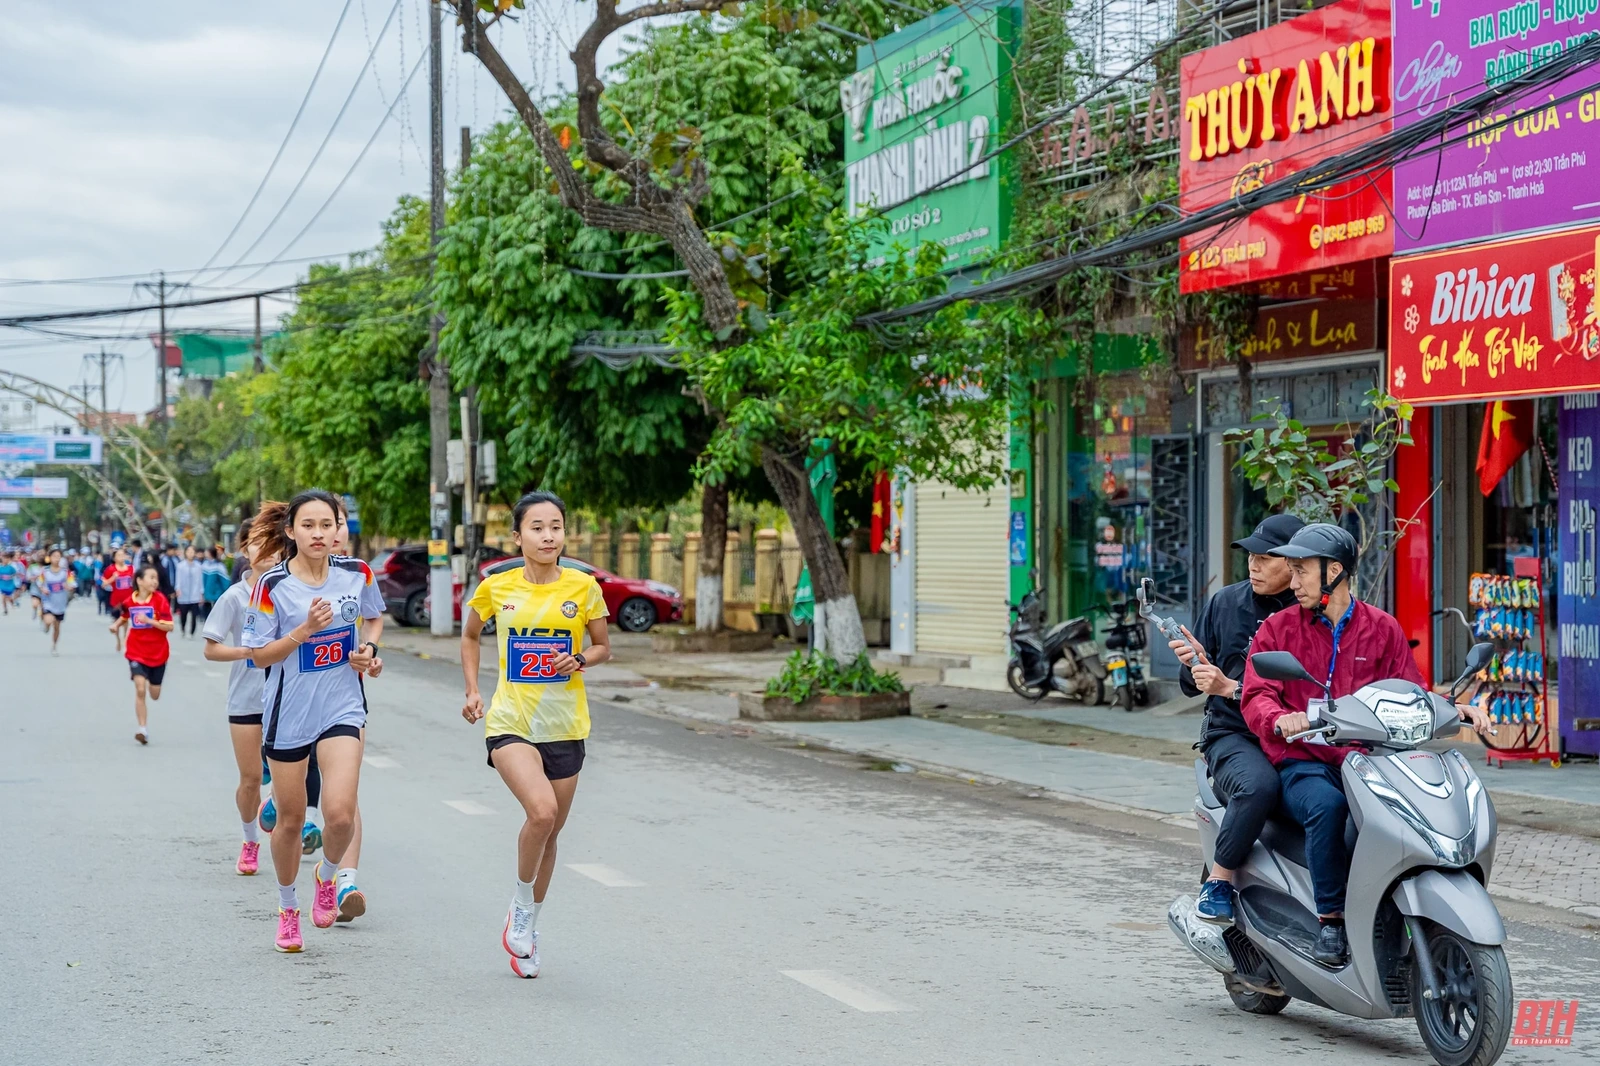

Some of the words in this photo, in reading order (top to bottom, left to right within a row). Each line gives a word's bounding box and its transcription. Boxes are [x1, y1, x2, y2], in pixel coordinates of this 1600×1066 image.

[1470, 14, 1495, 49] BIA
[1498, 1, 1540, 40] RƯỢU
[1291, 37, 1377, 135] ANH
[913, 115, 964, 194] BÌNH
[969, 115, 989, 178] 2
[1407, 187, 1421, 201] Add:
[1467, 171, 1483, 188] Trần
[1483, 169, 1497, 185] Phú
[1553, 153, 1570, 172] Trần
[1571, 151, 1586, 168] Phú
[932, 208, 941, 224] 2
[1432, 201, 1441, 216] Ba
[1442, 197, 1457, 213] Đình
[1488, 189, 1502, 205] Sơn
[1507, 183, 1529, 201] Thanh
[1529, 180, 1545, 197] Hoá
[1247, 237, 1267, 260] PHÚ
[1324, 223, 1347, 244] 0342
[1347, 218, 1366, 239] 999
[1366, 214, 1385, 235] 969
[1430, 263, 1535, 326] Bibica
[1310, 309, 1357, 350] Lụa
[1511, 321, 1544, 372] Việt
[1568, 436, 1593, 479] KẸO
[314, 641, 343, 667] 26
[520, 652, 558, 678] 25
[1561, 623, 1599, 667] NGOẠI
